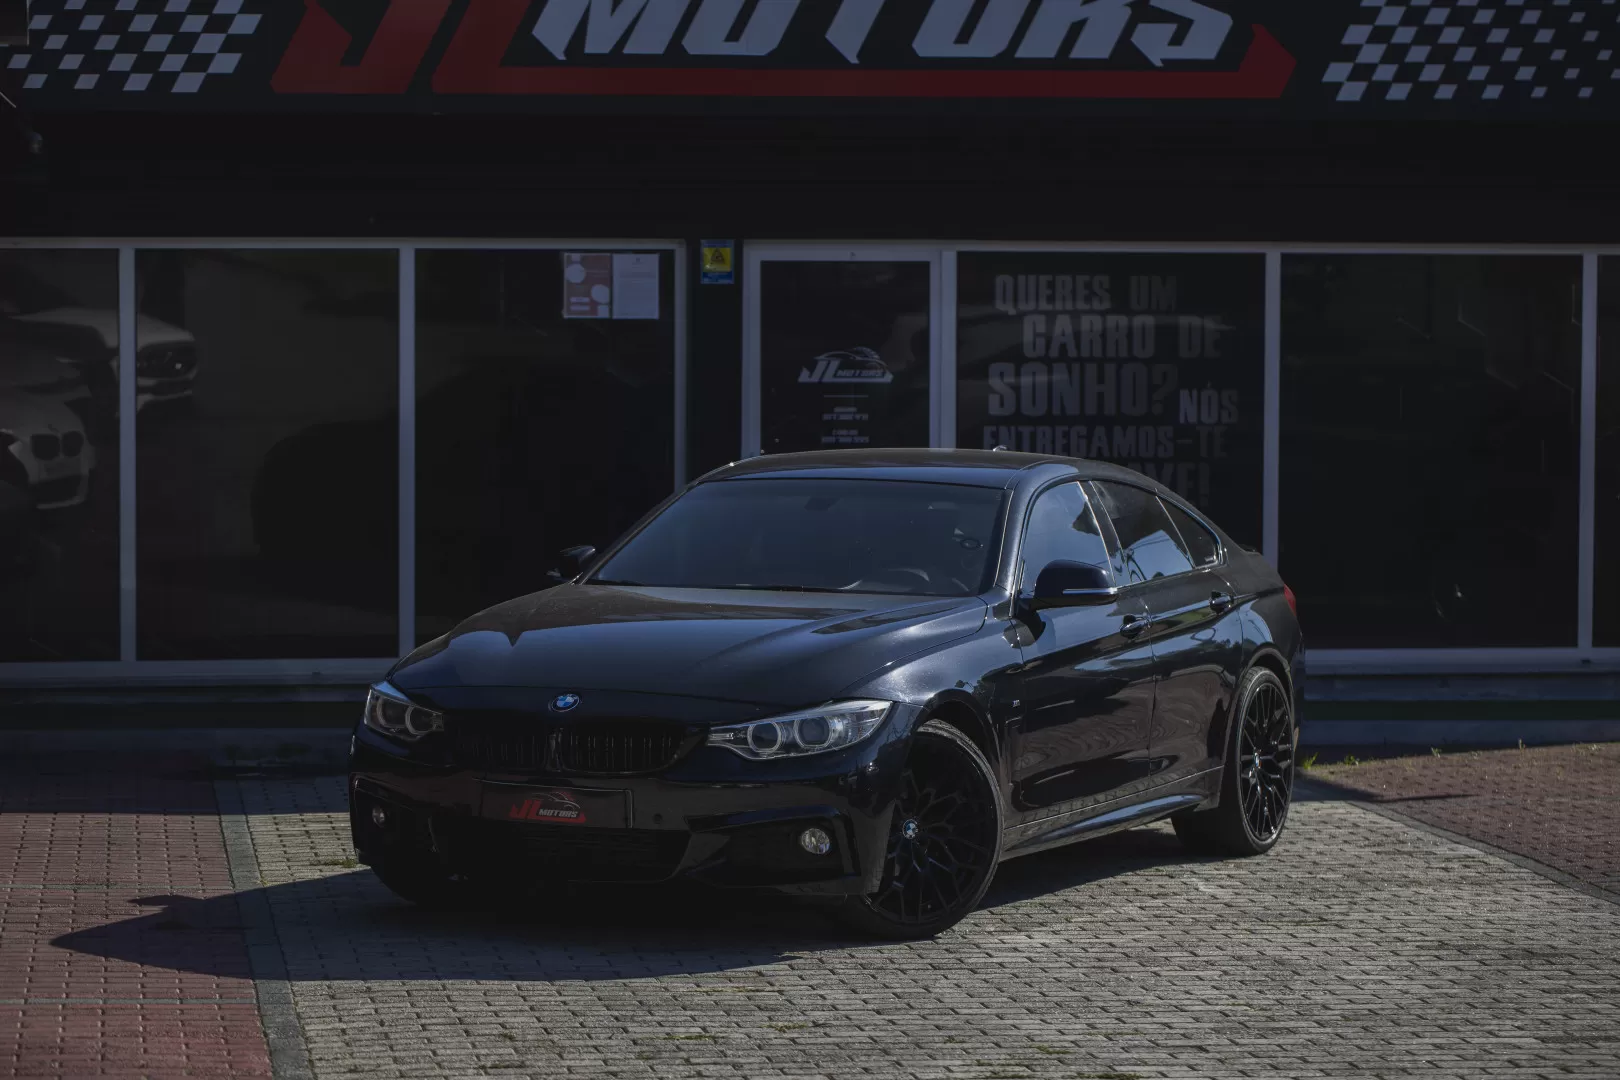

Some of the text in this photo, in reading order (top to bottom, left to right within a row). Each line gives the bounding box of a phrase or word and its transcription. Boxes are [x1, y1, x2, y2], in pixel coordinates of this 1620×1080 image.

[994, 274, 1177, 315] QUERES UM
[1022, 314, 1222, 358] CARRO DE
[987, 362, 1239, 424] SONHO? NÓS
[538, 808, 579, 818] MOTORS
